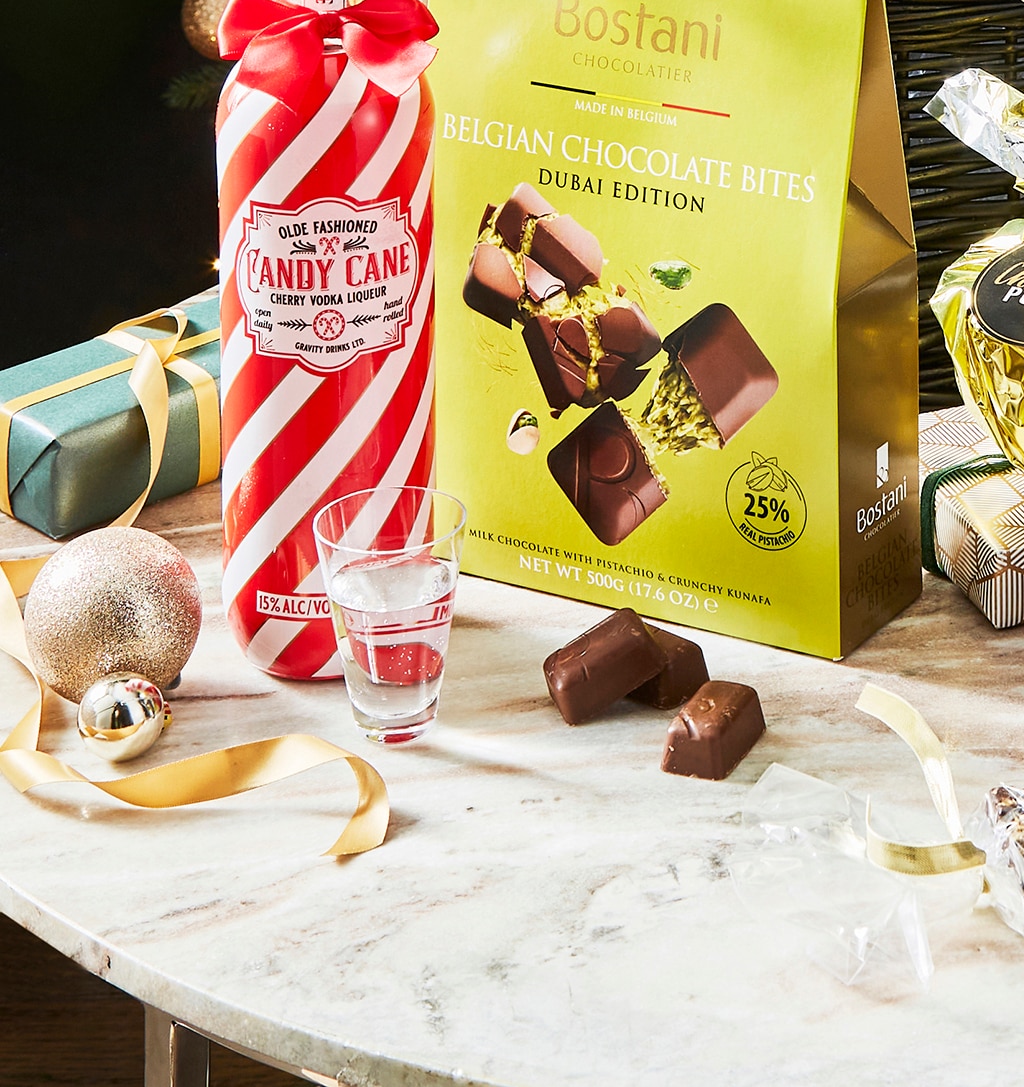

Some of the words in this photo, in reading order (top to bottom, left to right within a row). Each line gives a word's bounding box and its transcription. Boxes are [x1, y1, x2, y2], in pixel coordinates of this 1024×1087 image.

[572, 52, 693, 83] CHOCOLATIER
[574, 99, 608, 114] MADE
[610, 105, 624, 117] IN
[627, 107, 677, 126] BELGIUM
[442, 113, 553, 157] BELGIAN
[561, 134, 732, 188] CHOCOLATE
[741, 165, 816, 203] BITES
[538, 168, 602, 195] DUBAI
[612, 181, 705, 213] EDITION
[278, 222, 309, 240] OLDE
[313, 220, 378, 234] FASHIONED
[246, 248, 335, 293] CANDY
[345, 241, 410, 288] CANE
[270, 292, 305, 306] CHERRY
[310, 292, 343, 306] VODKA
[347, 285, 387, 304] LIQUEUR
[383, 296, 403, 311] hand
[253, 320, 273, 332] daily
[254, 308, 272, 318] open
[382, 308, 404, 323] rolled
[295, 341, 323, 354] GRAVITY
[325, 343, 350, 354] DRINKS
[744, 492, 790, 523] 25%
[856, 475, 907, 534] Bostani
[739, 522, 757, 542] REAL
[758, 530, 796, 547] PISTACHIO
[863, 508, 901, 542] CHOCOLATIER
[469, 529, 495, 542] MILK
[498, 535, 560, 557] CHOCOLATE
[563, 550, 592, 565] WITH
[596, 558, 654, 579] PISTACHIO
[657, 573, 665, 582] &
[668, 575, 723, 595] CRUNCHY
[727, 588, 771, 606] KUNAFA
[857, 528, 908, 582] BELGIAN
[519, 555, 552, 575] NET
[555, 562, 582, 582] WT
[587, 570, 624, 592] 500G
[629, 580, 665, 602] (17.6
[669, 590, 700, 611] OZ)
[258, 594, 281, 613] 15%
[282, 598, 330, 616] ALC/VO
